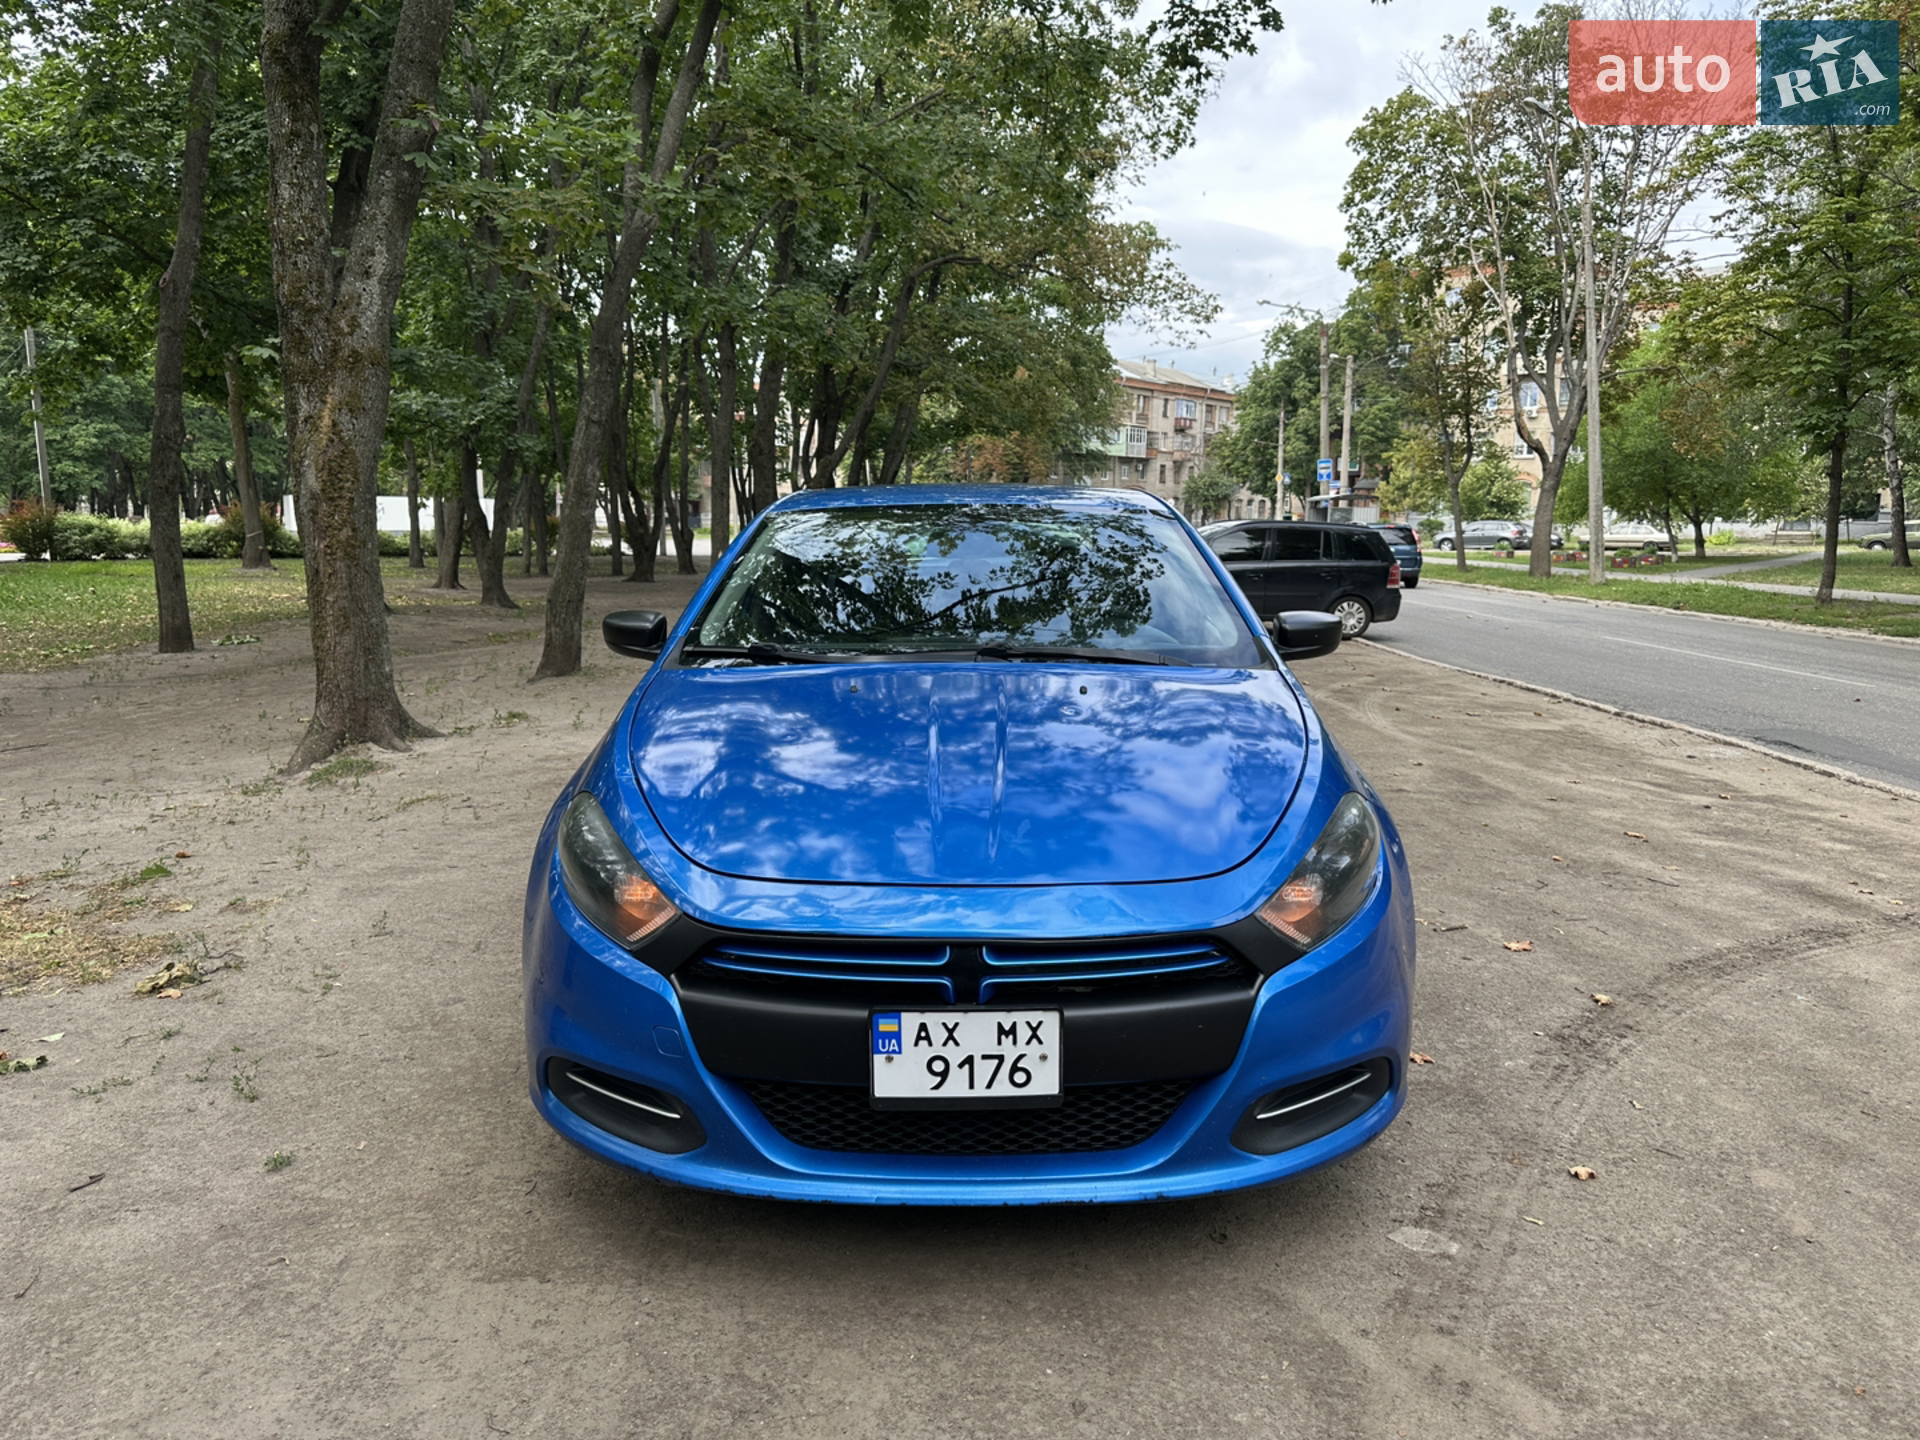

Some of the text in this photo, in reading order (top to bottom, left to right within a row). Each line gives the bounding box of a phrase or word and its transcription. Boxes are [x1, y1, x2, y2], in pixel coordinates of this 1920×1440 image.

[878, 1039, 900, 1053] UA
[913, 1020, 1044, 1048] AX MX
[926, 1053, 1033, 1090] 9176
